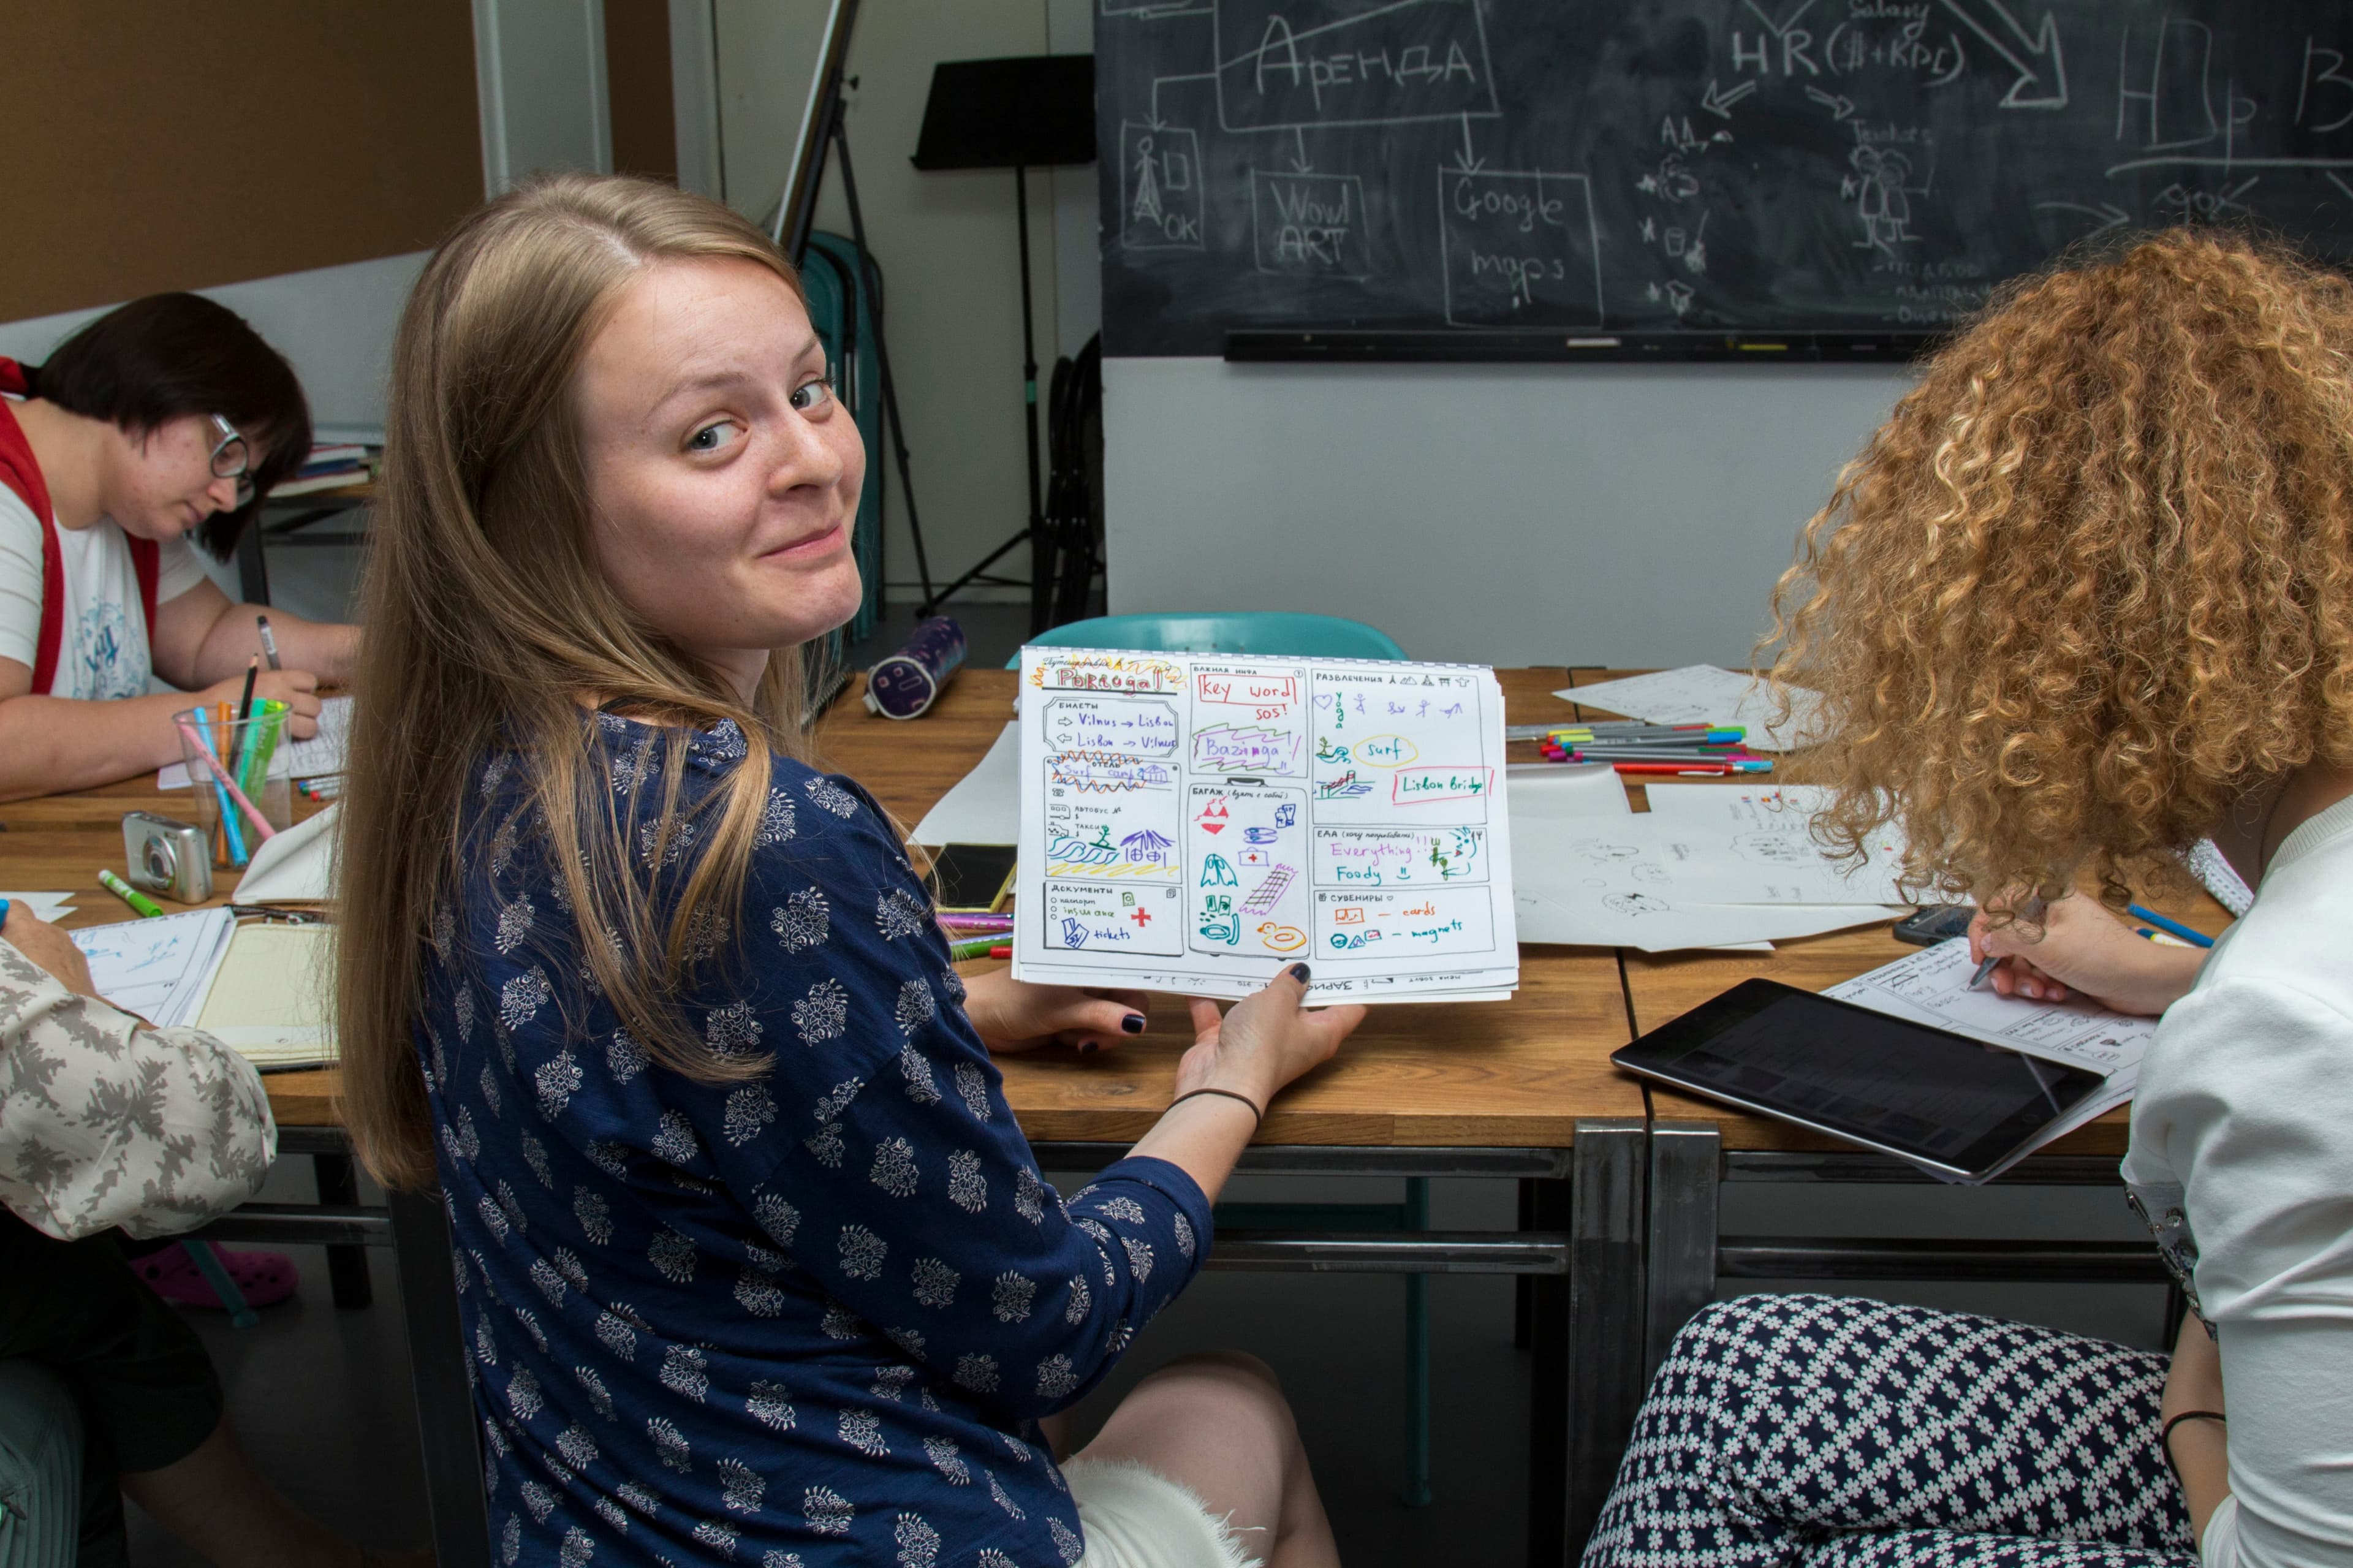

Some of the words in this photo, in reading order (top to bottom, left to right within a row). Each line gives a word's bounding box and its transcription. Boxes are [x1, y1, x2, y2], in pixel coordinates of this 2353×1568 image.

[1453, 167, 1564, 233] Google
[1316, 673, 1383, 683] РАЗВЛЕЧЕНИЯ
[1250, 678, 1290, 698] word
[1192, 787, 1224, 796] БАГАЖ
[1336, 866, 1382, 887] Foody
[1051, 884, 1113, 895] ДОКУМЕНТЫ
[1403, 901, 1436, 916] cards
[1094, 926, 1131, 941] tickets
[1411, 918, 1463, 944] magnets
